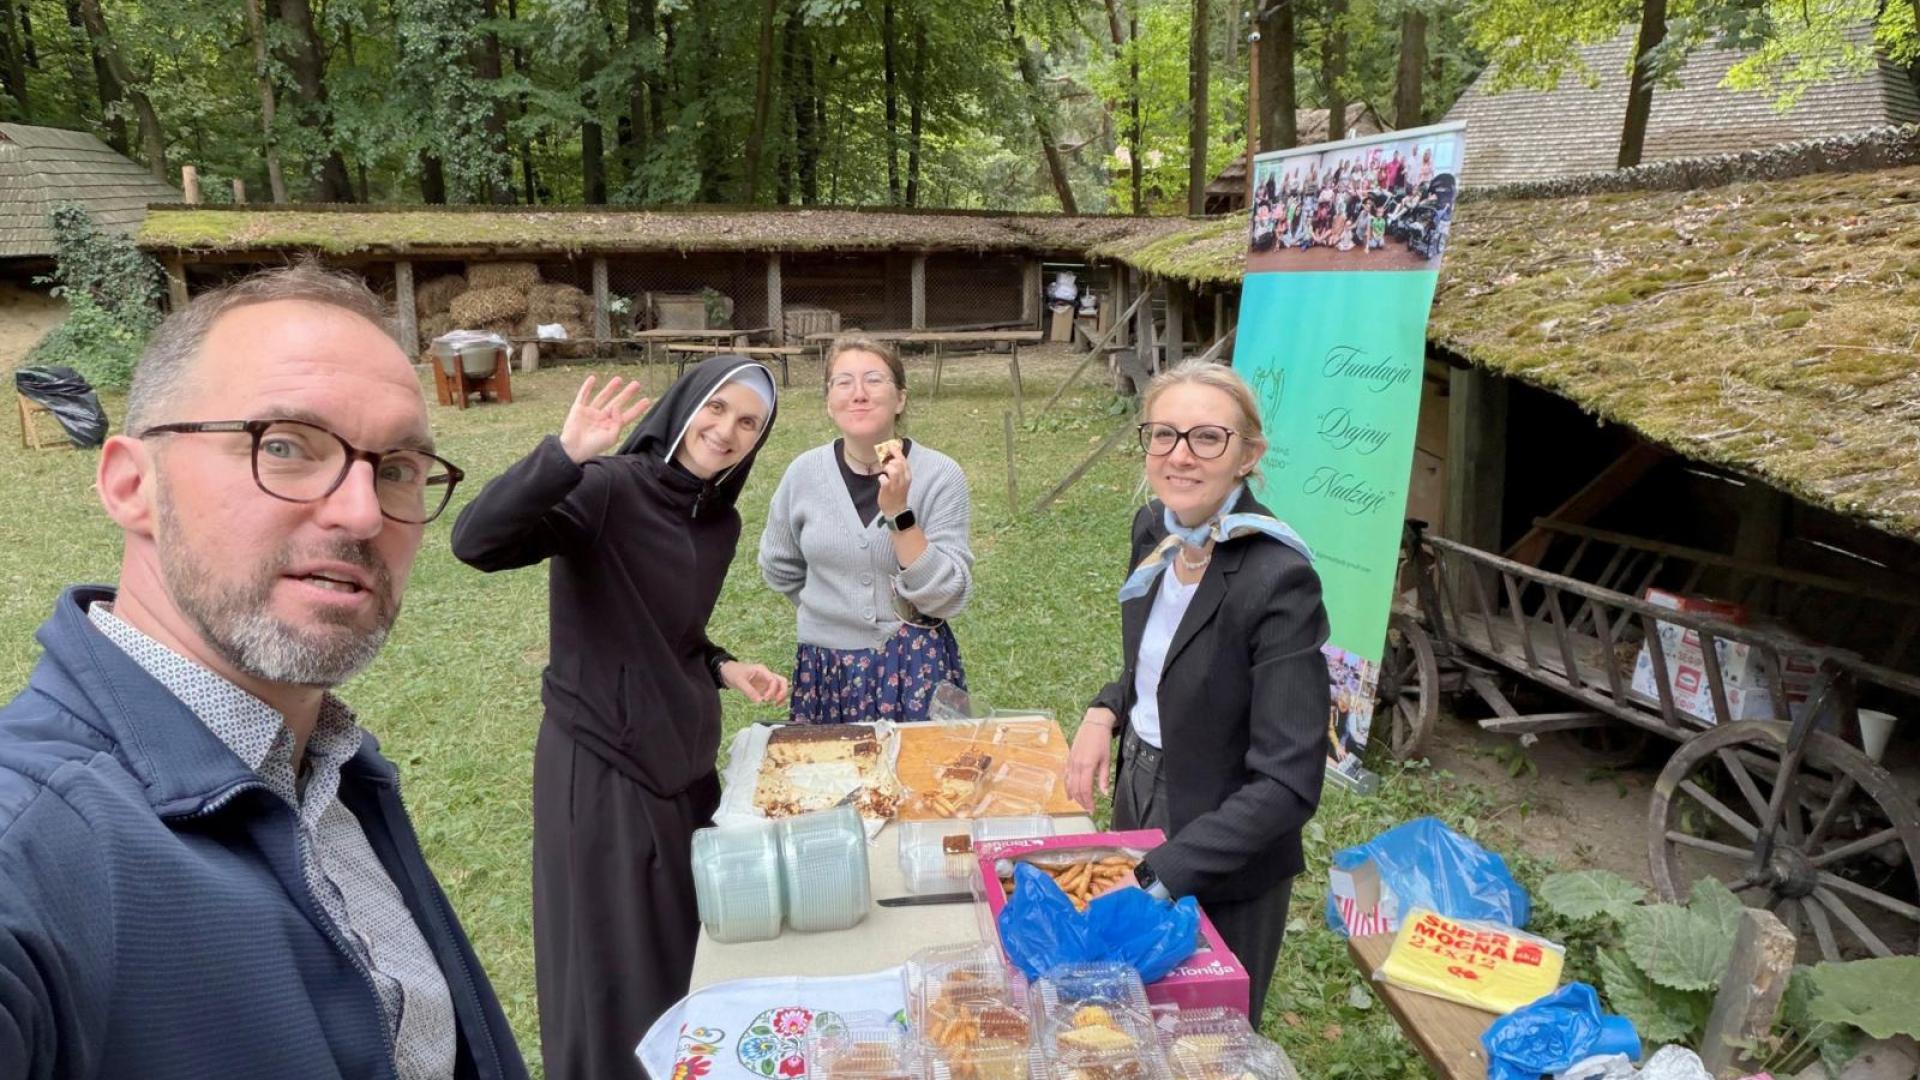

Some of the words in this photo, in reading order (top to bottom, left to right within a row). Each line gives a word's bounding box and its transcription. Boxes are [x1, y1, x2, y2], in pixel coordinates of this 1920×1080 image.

[1322, 345, 1411, 393] Fundacja
[1414, 922, 1508, 960] MOCNA
[1423, 914, 1510, 947] SUPER
